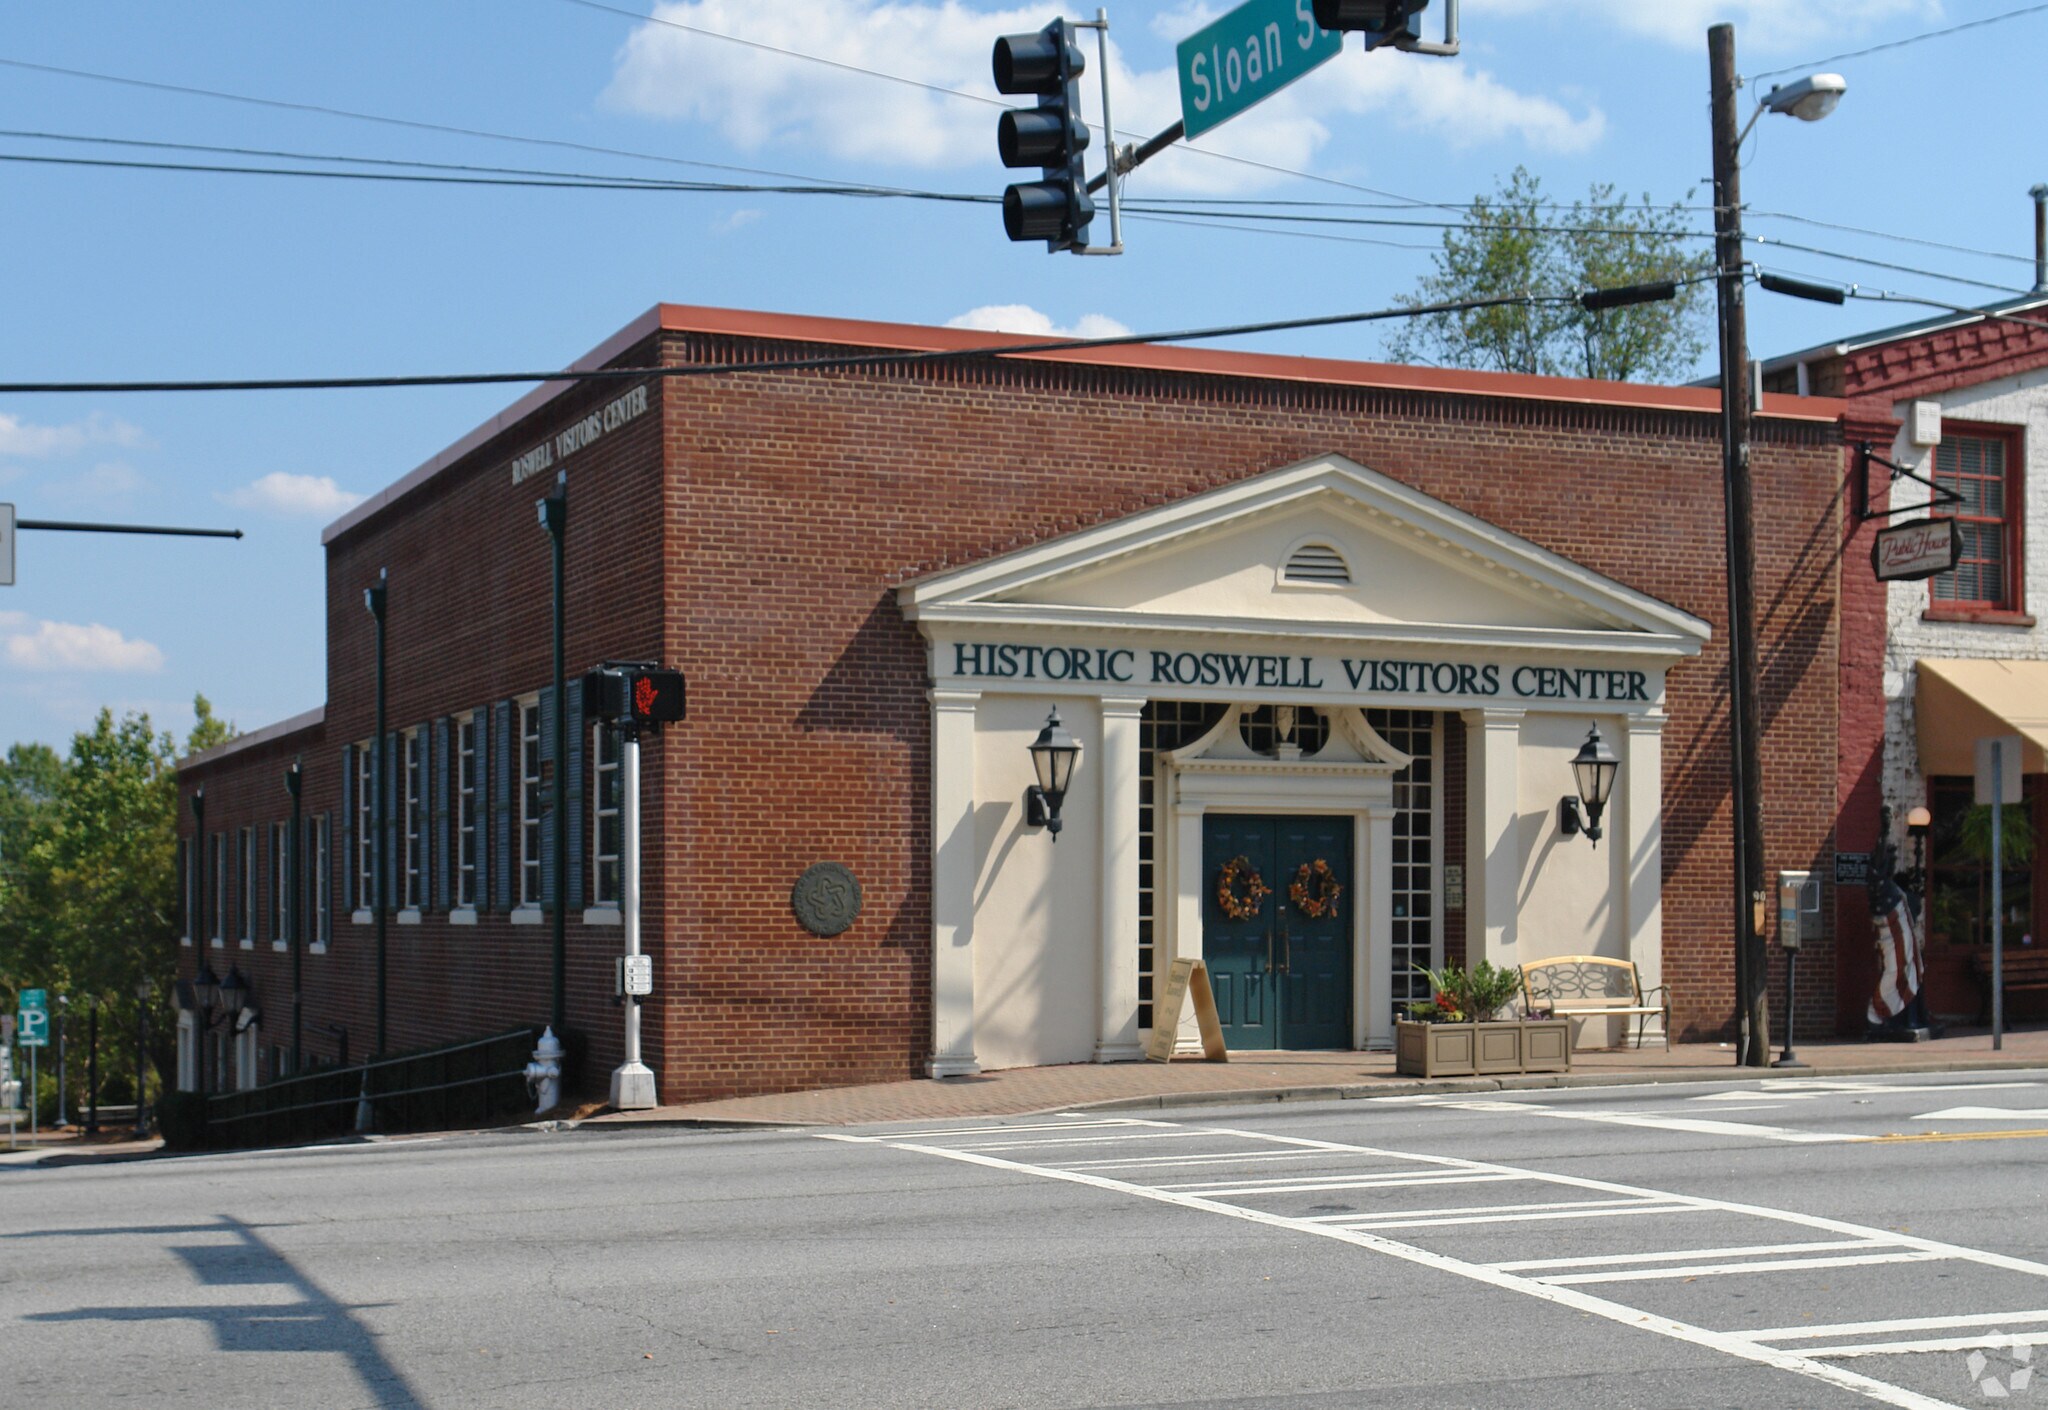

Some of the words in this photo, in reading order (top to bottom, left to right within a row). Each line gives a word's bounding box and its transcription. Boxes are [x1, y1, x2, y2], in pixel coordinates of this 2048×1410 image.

[1191, 22, 1283, 112] Sloan
[1295, 0, 1328, 50] S
[556, 411, 602, 459] VISITORS
[604, 385, 648, 433] CENTER
[953, 642, 1135, 682] HISTORIC
[1150, 650, 1324, 689] ROSWELL
[1341, 659, 1500, 695] VISITORS
[1512, 666, 1650, 702] CENTER
[18, 1009, 45, 1036] P
